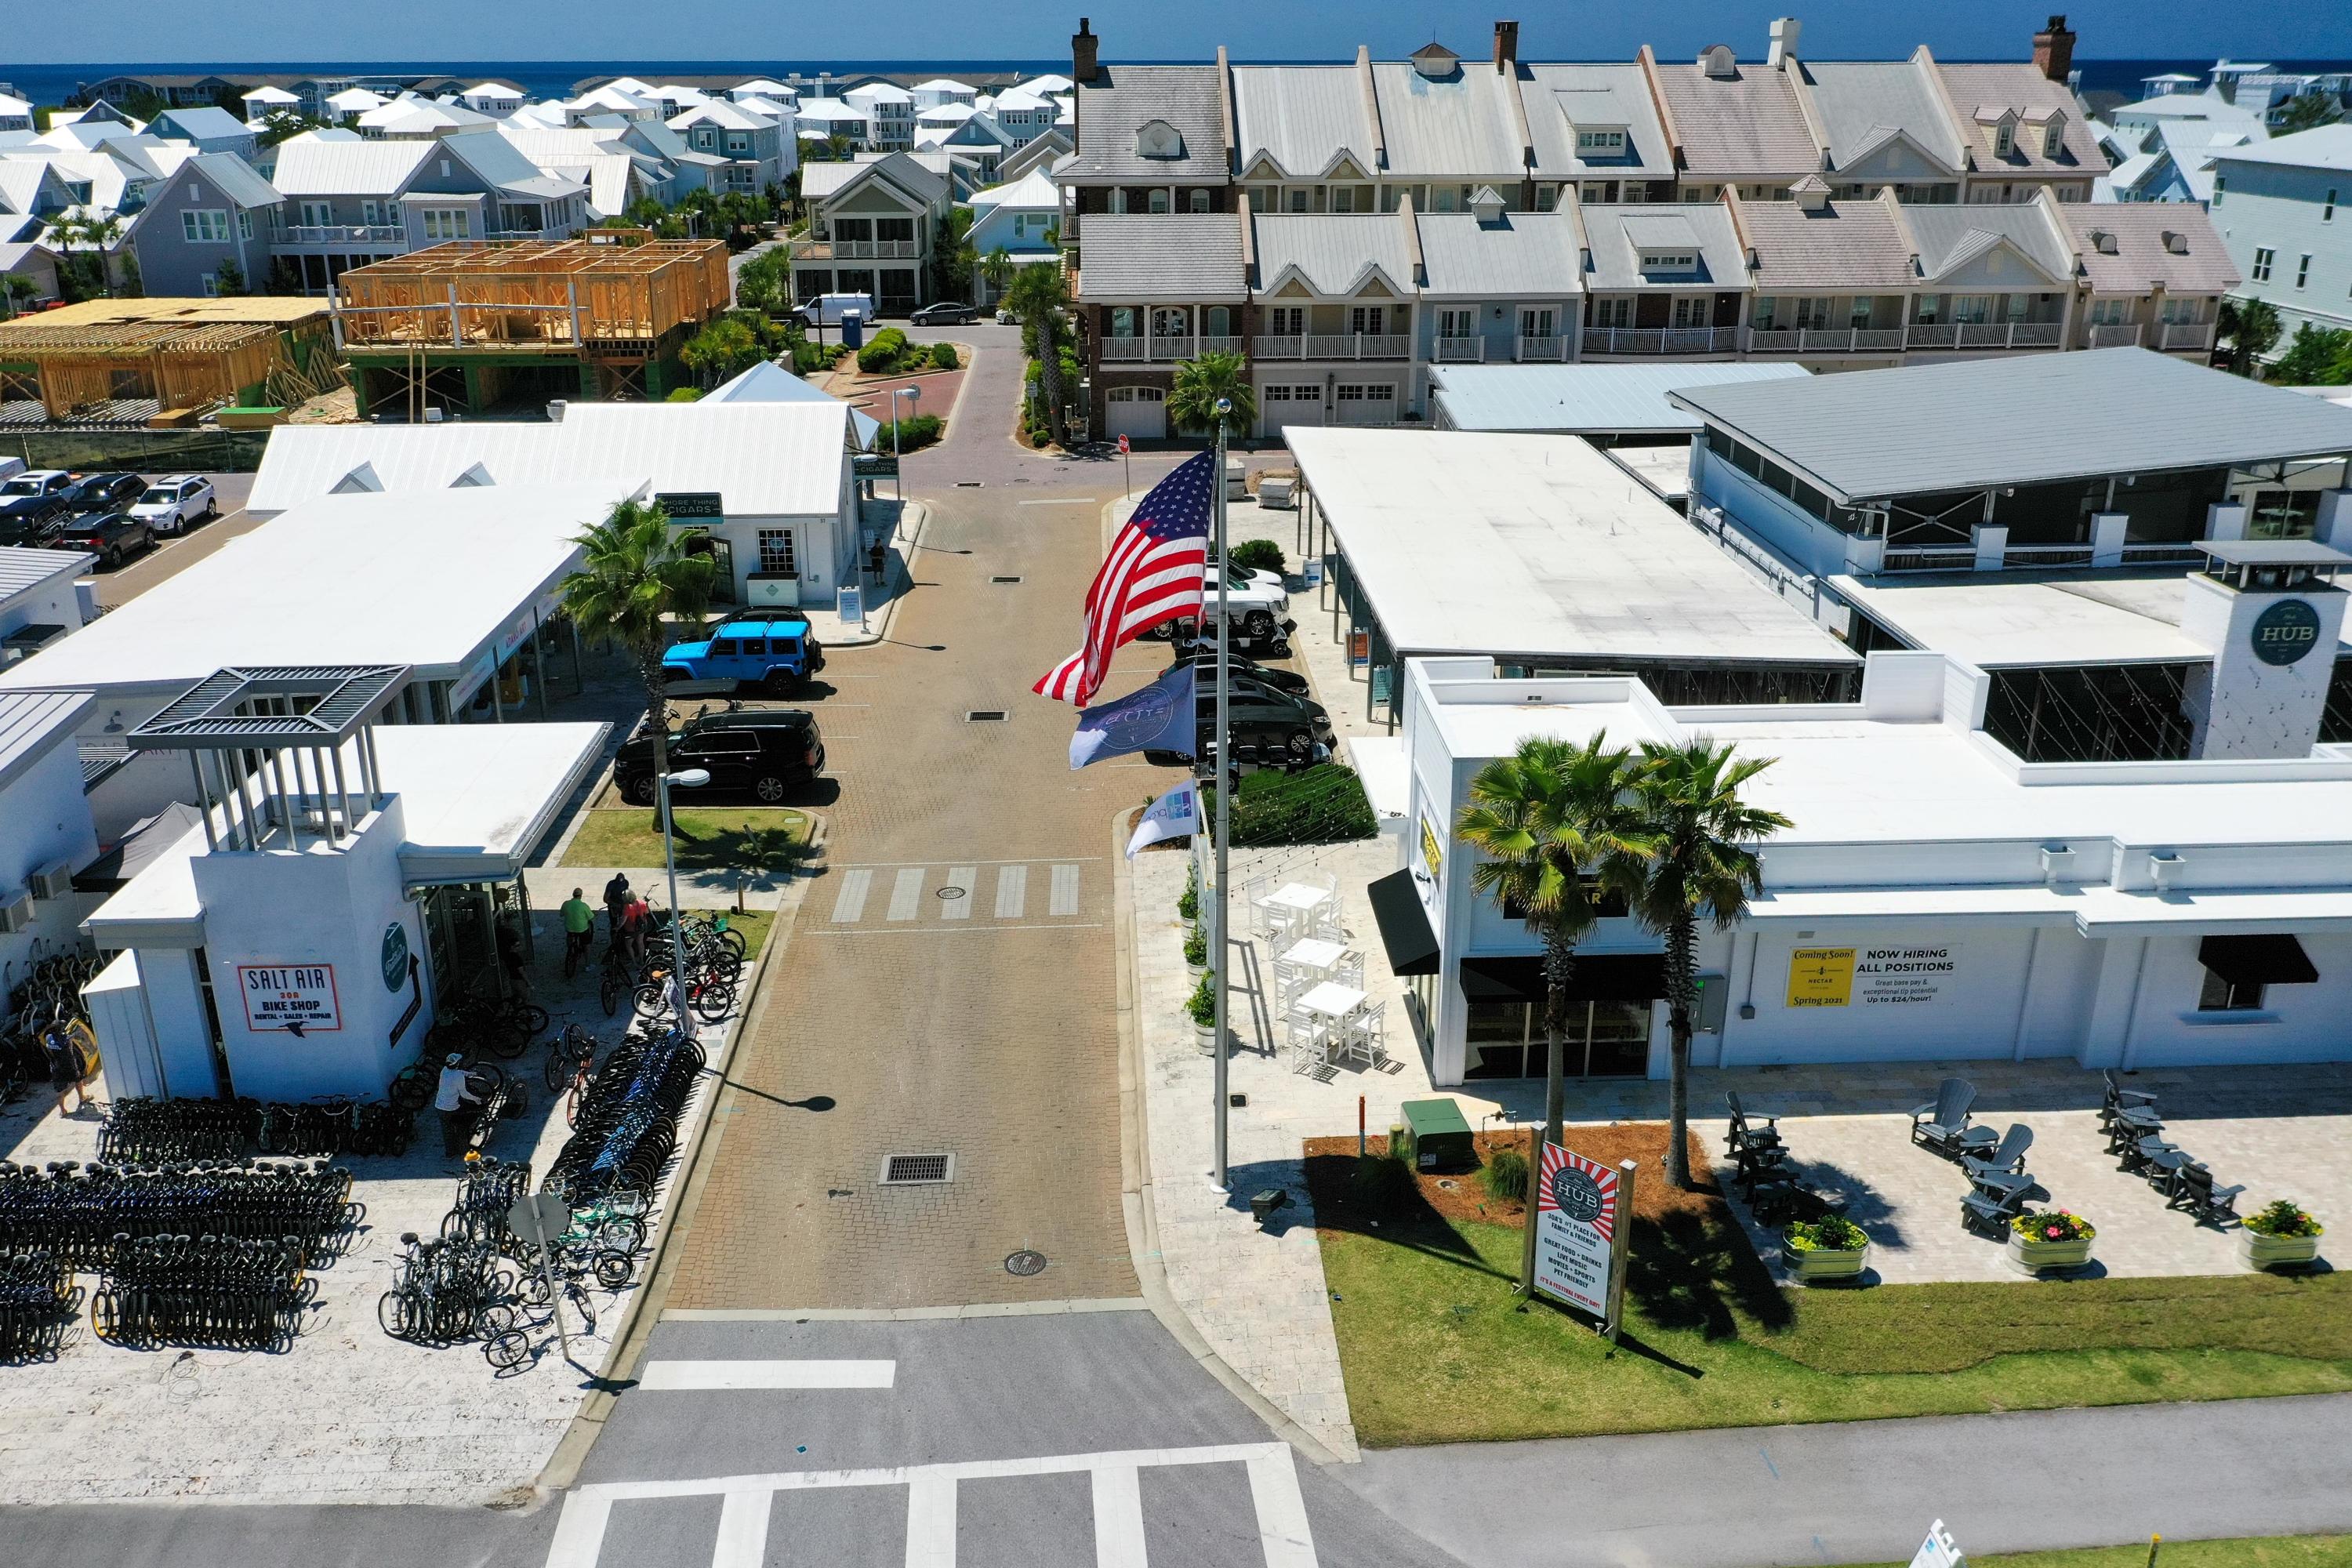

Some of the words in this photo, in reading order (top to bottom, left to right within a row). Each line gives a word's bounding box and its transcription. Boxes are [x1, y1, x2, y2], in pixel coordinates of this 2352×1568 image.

[1119, 440, 1128, 448] STOP
[2261, 627, 2314, 641] HUB
[1794, 950, 1827, 960] Coming
[1828, 950, 1853, 960] Soon!
[1867, 950, 1900, 959] NOW
[1903, 949, 1947, 958] HIRING
[1857, 964, 1881, 972] ALL
[1885, 962, 1954, 972] POSITIONS
[248, 969, 288, 989] SALT
[295, 968, 325, 989] AIR
[262, 1001, 288, 1011] BIKE
[290, 1000, 320, 1011] SHOP
[1794, 996, 1822, 1006] Spring
[1556, 1181, 1597, 1208] HUB
[1548, 1213, 1563, 1223] 30A'S
[1573, 1224, 1589, 1236] PLACE
[1590, 1232, 1600, 1241] FOR
[1552, 1222, 1569, 1234] FAMILY
[1574, 1232, 1596, 1247] FRIENDS
[1544, 1237, 1560, 1249] GREAT
[1562, 1245, 1576, 1256] FOOD
[1581, 1254, 1602, 1269] DRINKS
[1557, 1252, 1568, 1261] LIVE
[1569, 1258, 1587, 1270] MUSIC
[1548, 1257, 1568, 1271] MOVIES
[1574, 1269, 1595, 1283] SPORTS
[1554, 1268, 1563, 1277] PET
[1564, 1273, 1588, 1289] FRIENDLY
[1552, 1283, 1573, 1297] FESTIVAL
[1573, 1291, 1588, 1304] EVERY
